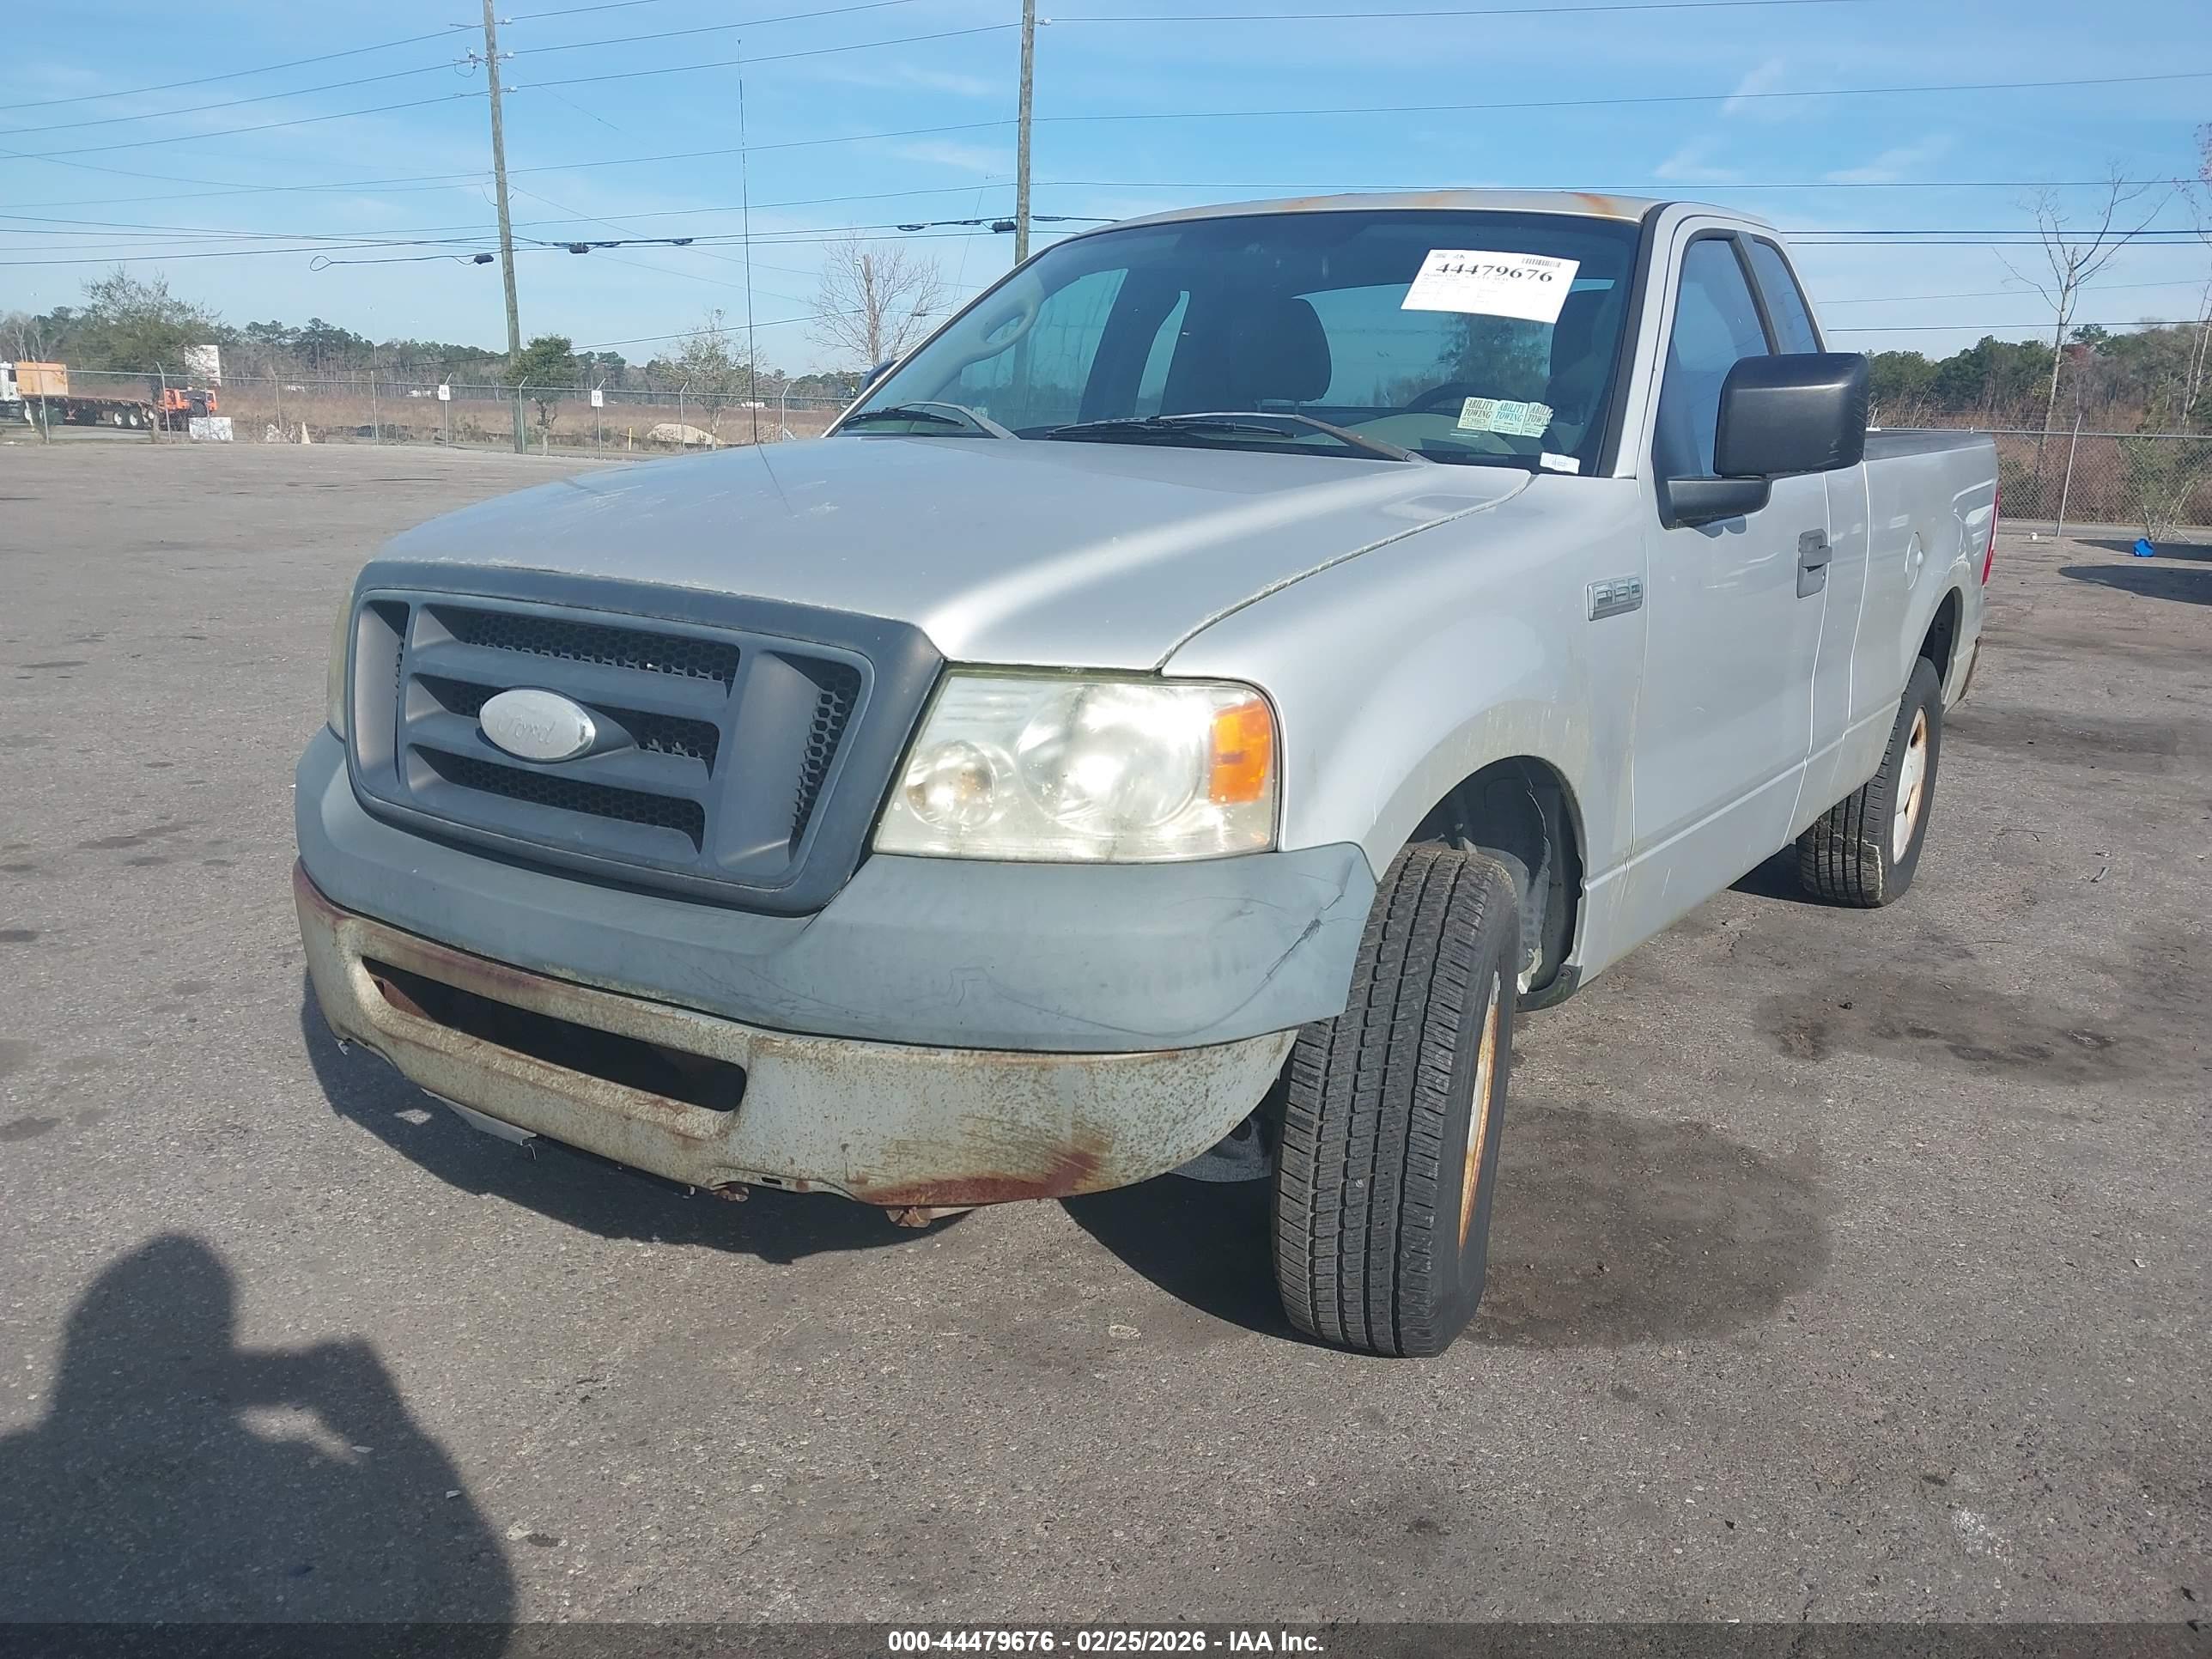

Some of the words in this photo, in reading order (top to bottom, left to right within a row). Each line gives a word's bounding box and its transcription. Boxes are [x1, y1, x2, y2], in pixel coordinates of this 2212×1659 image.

[1436, 263, 1553, 283] 44479676
[1467, 398, 1494, 410] ABILITY
[1498, 403, 1526, 414] ABILITY
[1463, 409, 1492, 419] TOWING
[1495, 411, 1524, 422] TOWING
